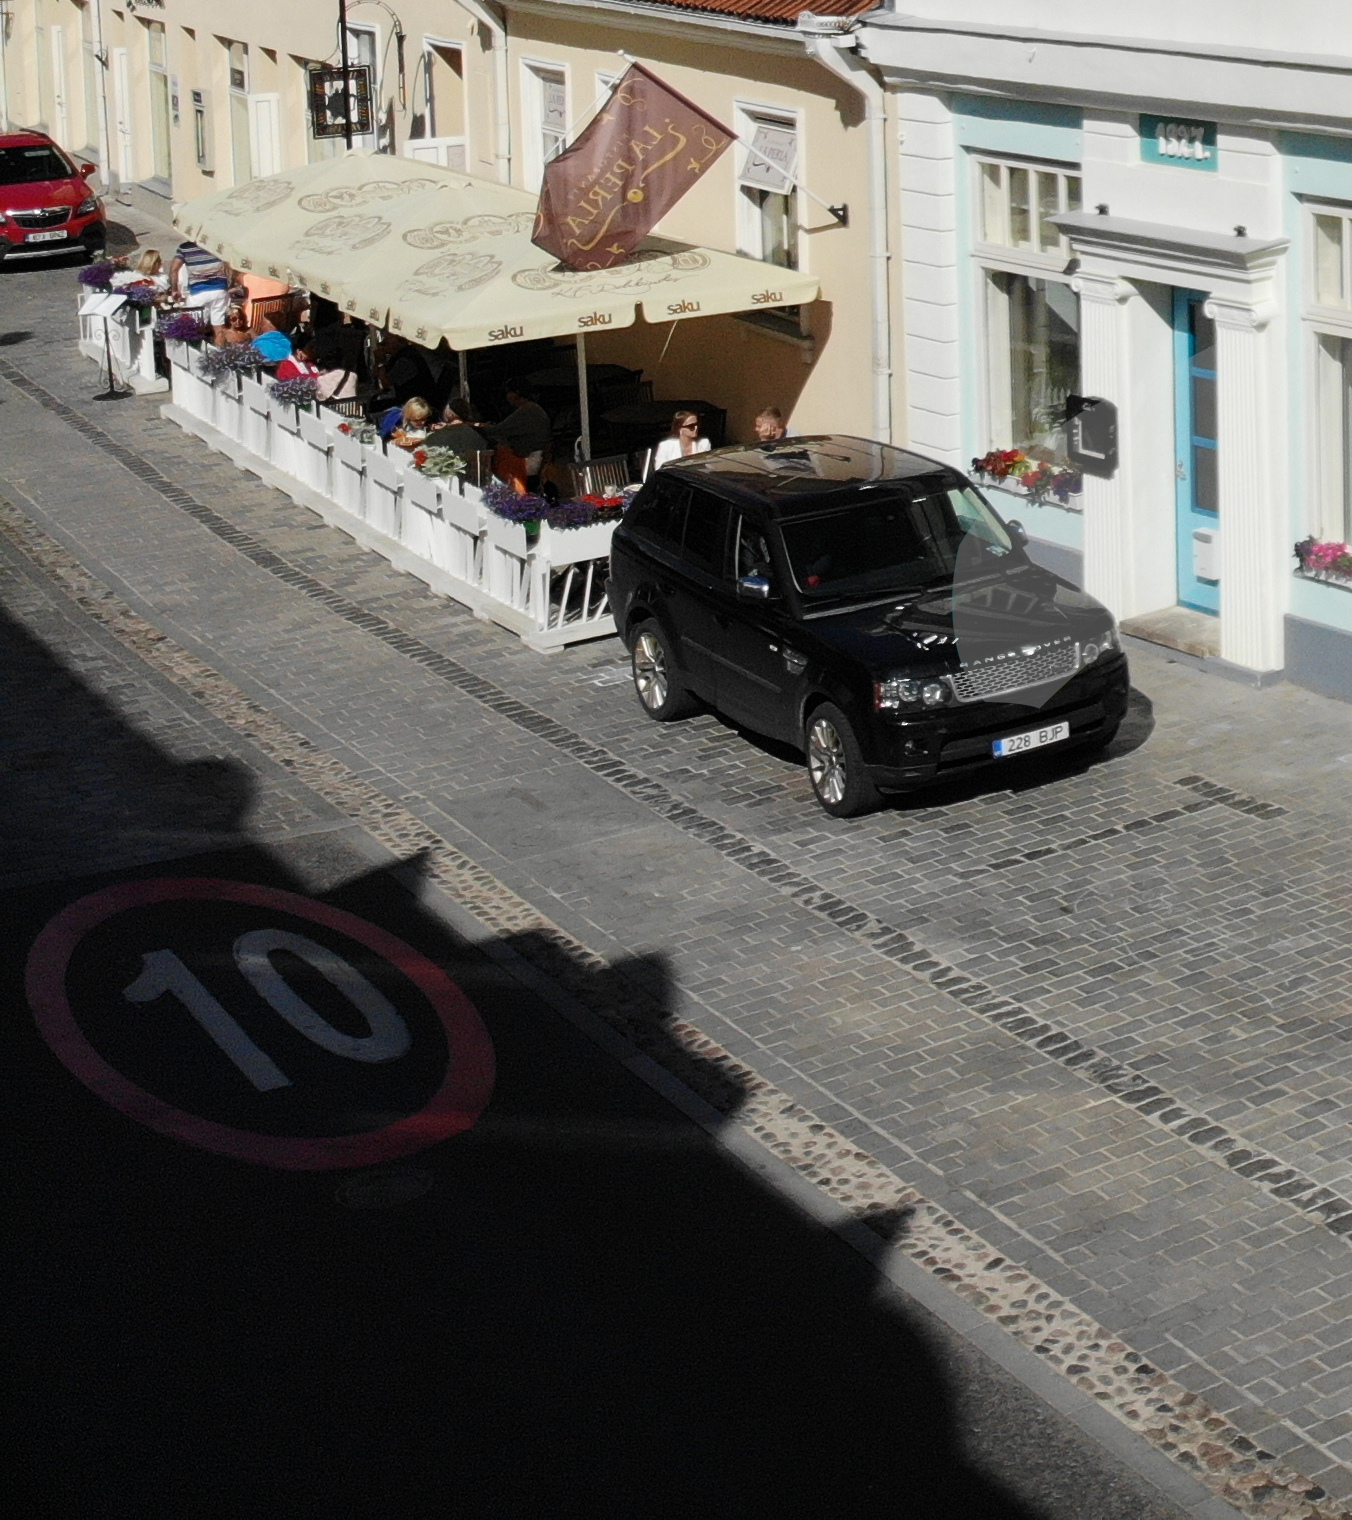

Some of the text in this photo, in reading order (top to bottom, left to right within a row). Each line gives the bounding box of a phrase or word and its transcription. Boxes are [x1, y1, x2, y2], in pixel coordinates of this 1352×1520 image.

[751, 289, 783, 304] saku
[667, 300, 701, 315] saku
[577, 311, 612, 328] saku
[488, 325, 524, 341] saku
[1021, 635, 1071, 656] OVER
[1008, 725, 1064, 752] 228 BJP
[121, 927, 411, 1092] 10
